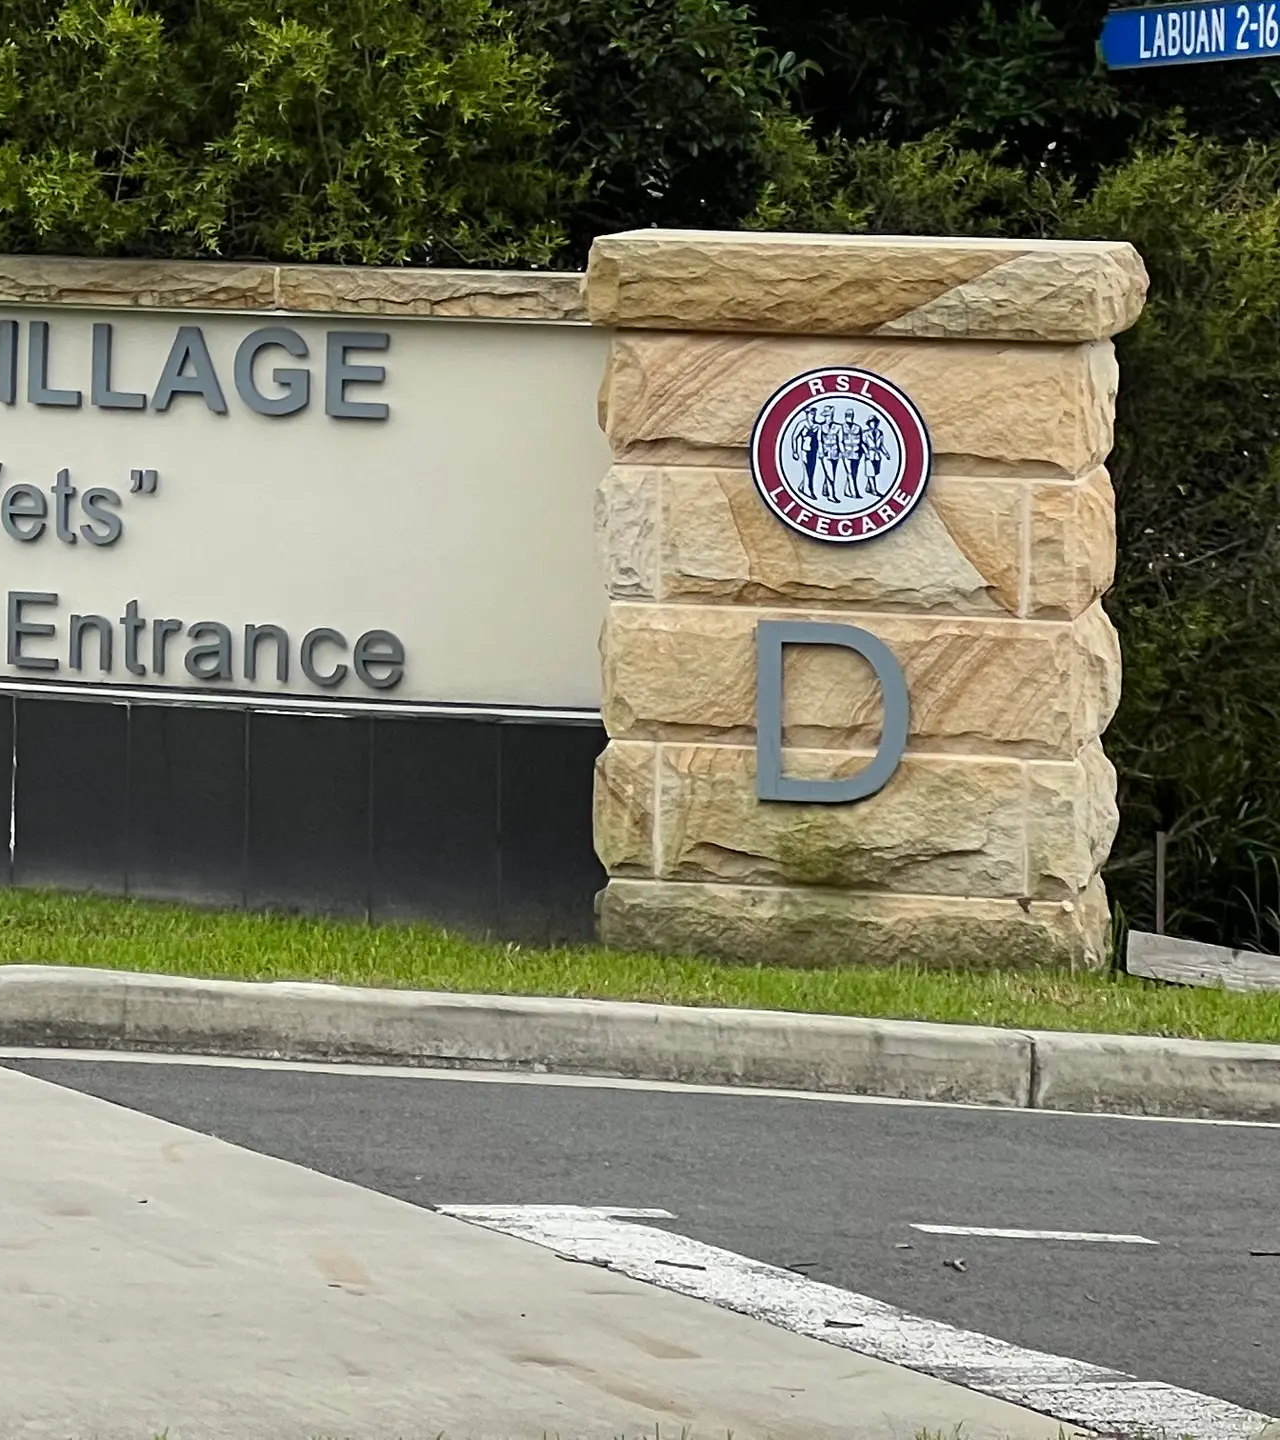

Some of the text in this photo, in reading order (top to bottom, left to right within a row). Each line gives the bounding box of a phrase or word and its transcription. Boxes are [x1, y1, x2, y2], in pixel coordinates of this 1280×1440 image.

[1140, 8, 1225, 58] LABUAN
[808, 375, 873, 398] RSL
[769, 486, 912, 536] LIFECARE
[6, 590, 407, 691] Entrance
[754, 619, 911, 803] D
